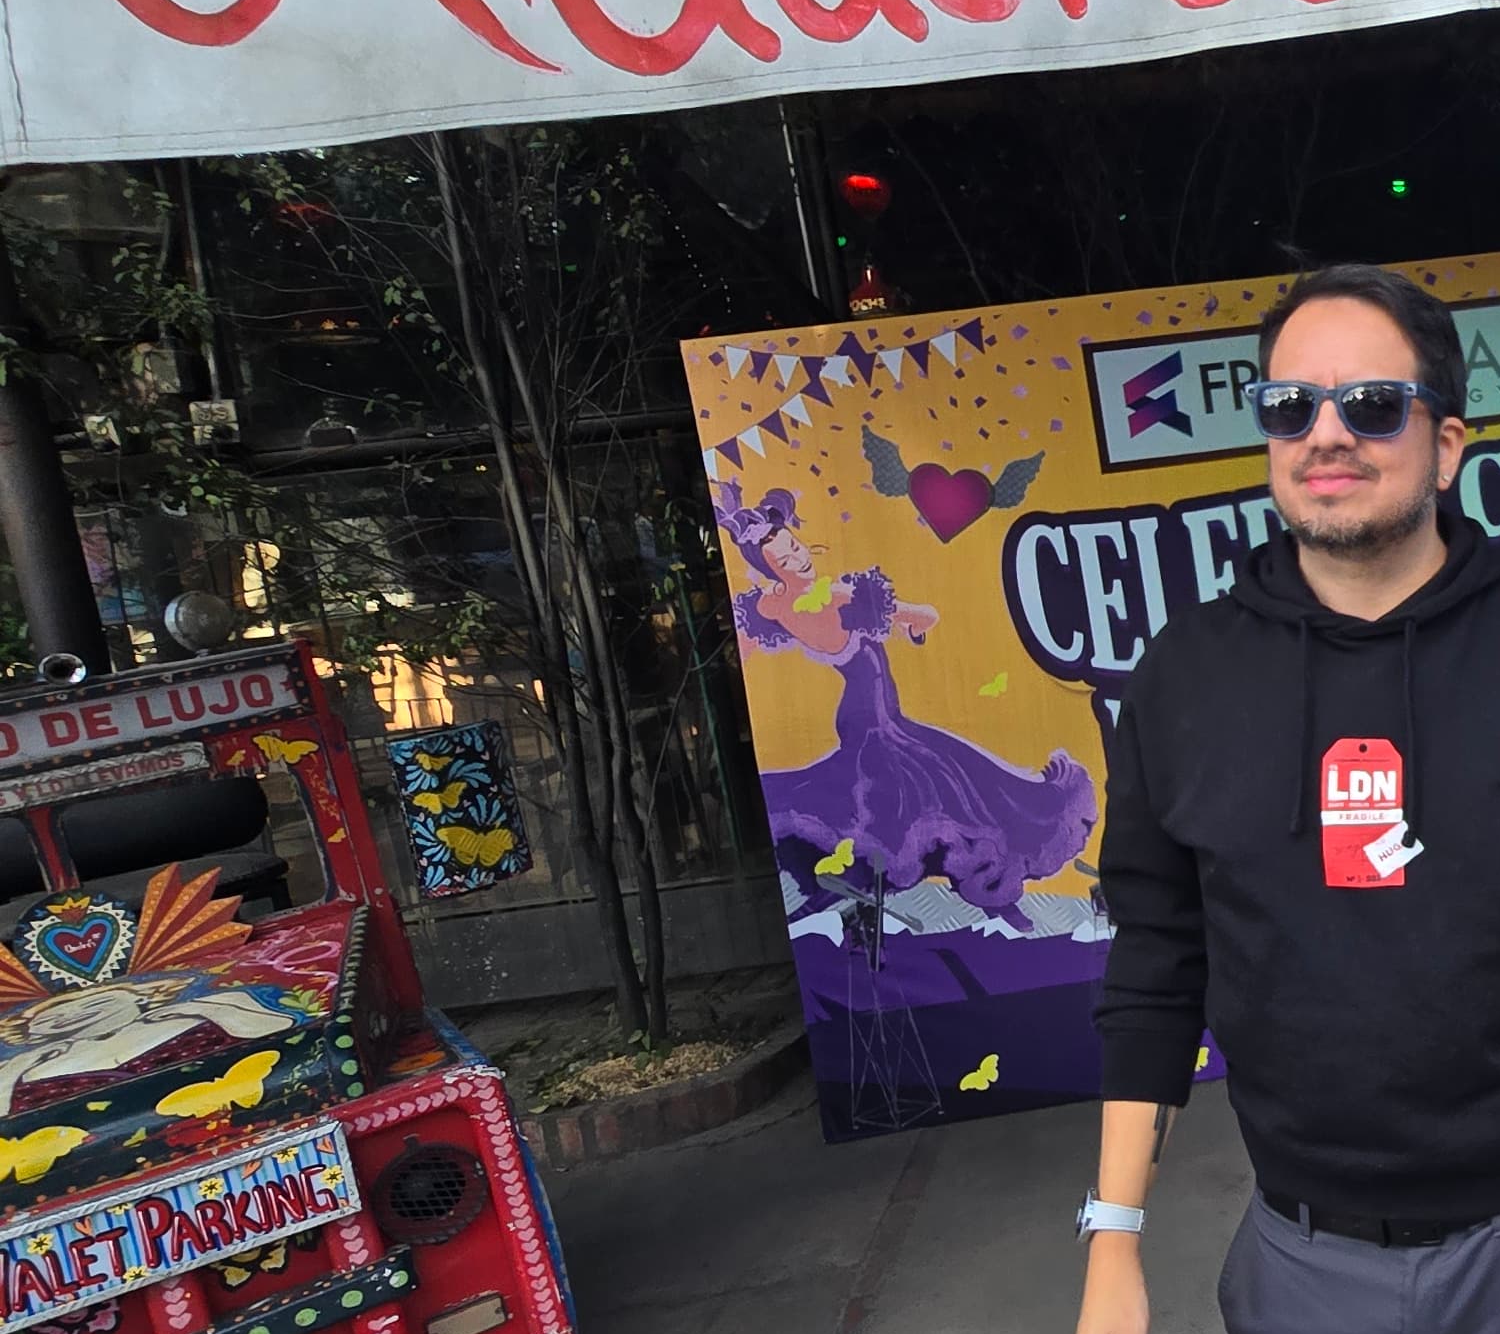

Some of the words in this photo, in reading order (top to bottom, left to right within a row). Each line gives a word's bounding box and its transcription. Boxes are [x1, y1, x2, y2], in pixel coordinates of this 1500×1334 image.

[39, 703, 119, 748] DE
[135, 673, 275, 730] LUJO
[1328, 770, 1396, 801] LDN
